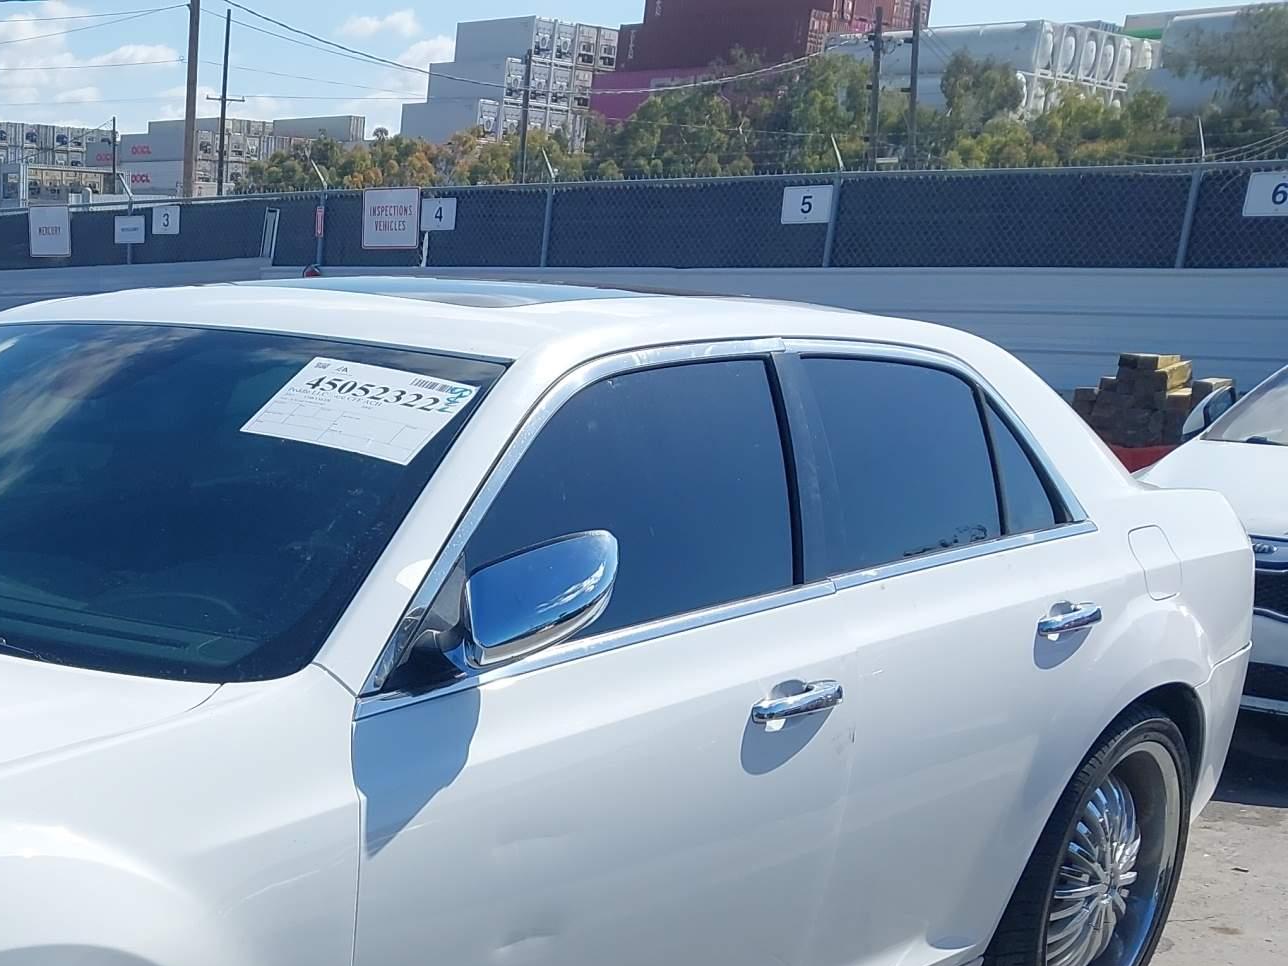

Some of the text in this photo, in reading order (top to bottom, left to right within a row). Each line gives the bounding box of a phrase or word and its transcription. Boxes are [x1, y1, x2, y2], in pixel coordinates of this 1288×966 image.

[1272, 182, 1288, 206] 6
[369, 204, 413, 217] INSPECTIONS
[801, 195, 813, 214] 5
[162, 213, 170, 228] 3
[434, 206, 444, 223] 4
[374, 220, 406, 232] VEHICLES
[305, 375, 441, 413] 45052322
